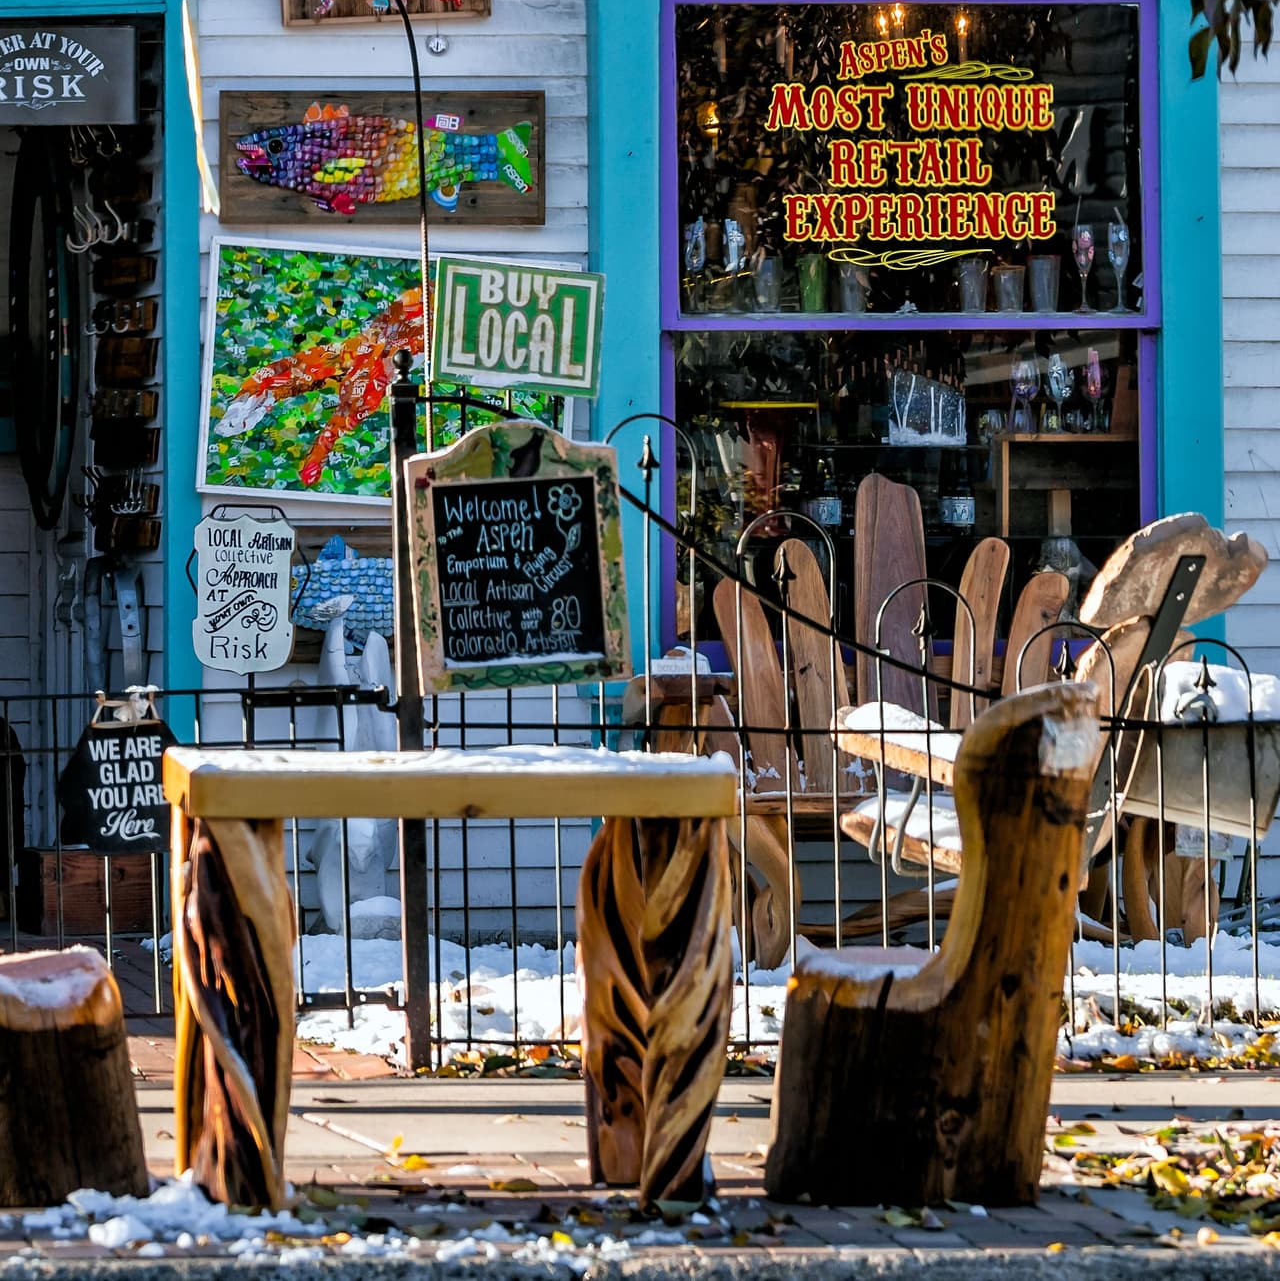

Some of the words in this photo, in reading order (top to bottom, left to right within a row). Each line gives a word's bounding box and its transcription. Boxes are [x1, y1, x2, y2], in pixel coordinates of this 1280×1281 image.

[14, 57, 50, 71] OWN
[29, 32, 56, 49] AT
[60, 36, 105, 77] YOUR
[766, 83, 894, 132] MOST
[907, 83, 1054, 132] UNIQUE
[828, 139, 992, 187] RETAIL
[783, 192, 1057, 243] EXPERIENCE
[479, 268, 558, 311] BUY
[451, 285, 584, 377] LOCAL
[444, 484, 542, 523] Welcome!
[208, 527, 242, 548] LOCAL
[447, 553, 508, 578] Emporium
[522, 546, 558, 579] Flying
[206, 589, 228, 602] AT
[485, 579, 534, 602] Artisan
[551, 596, 581, 632] 80
[210, 633, 269, 660] Risk
[88, 739, 120, 761] WE
[124, 736, 161, 758] ARE
[99, 761, 154, 785] GLAD
[88, 786, 128, 810] YOU
[100, 808, 161, 841] Here
